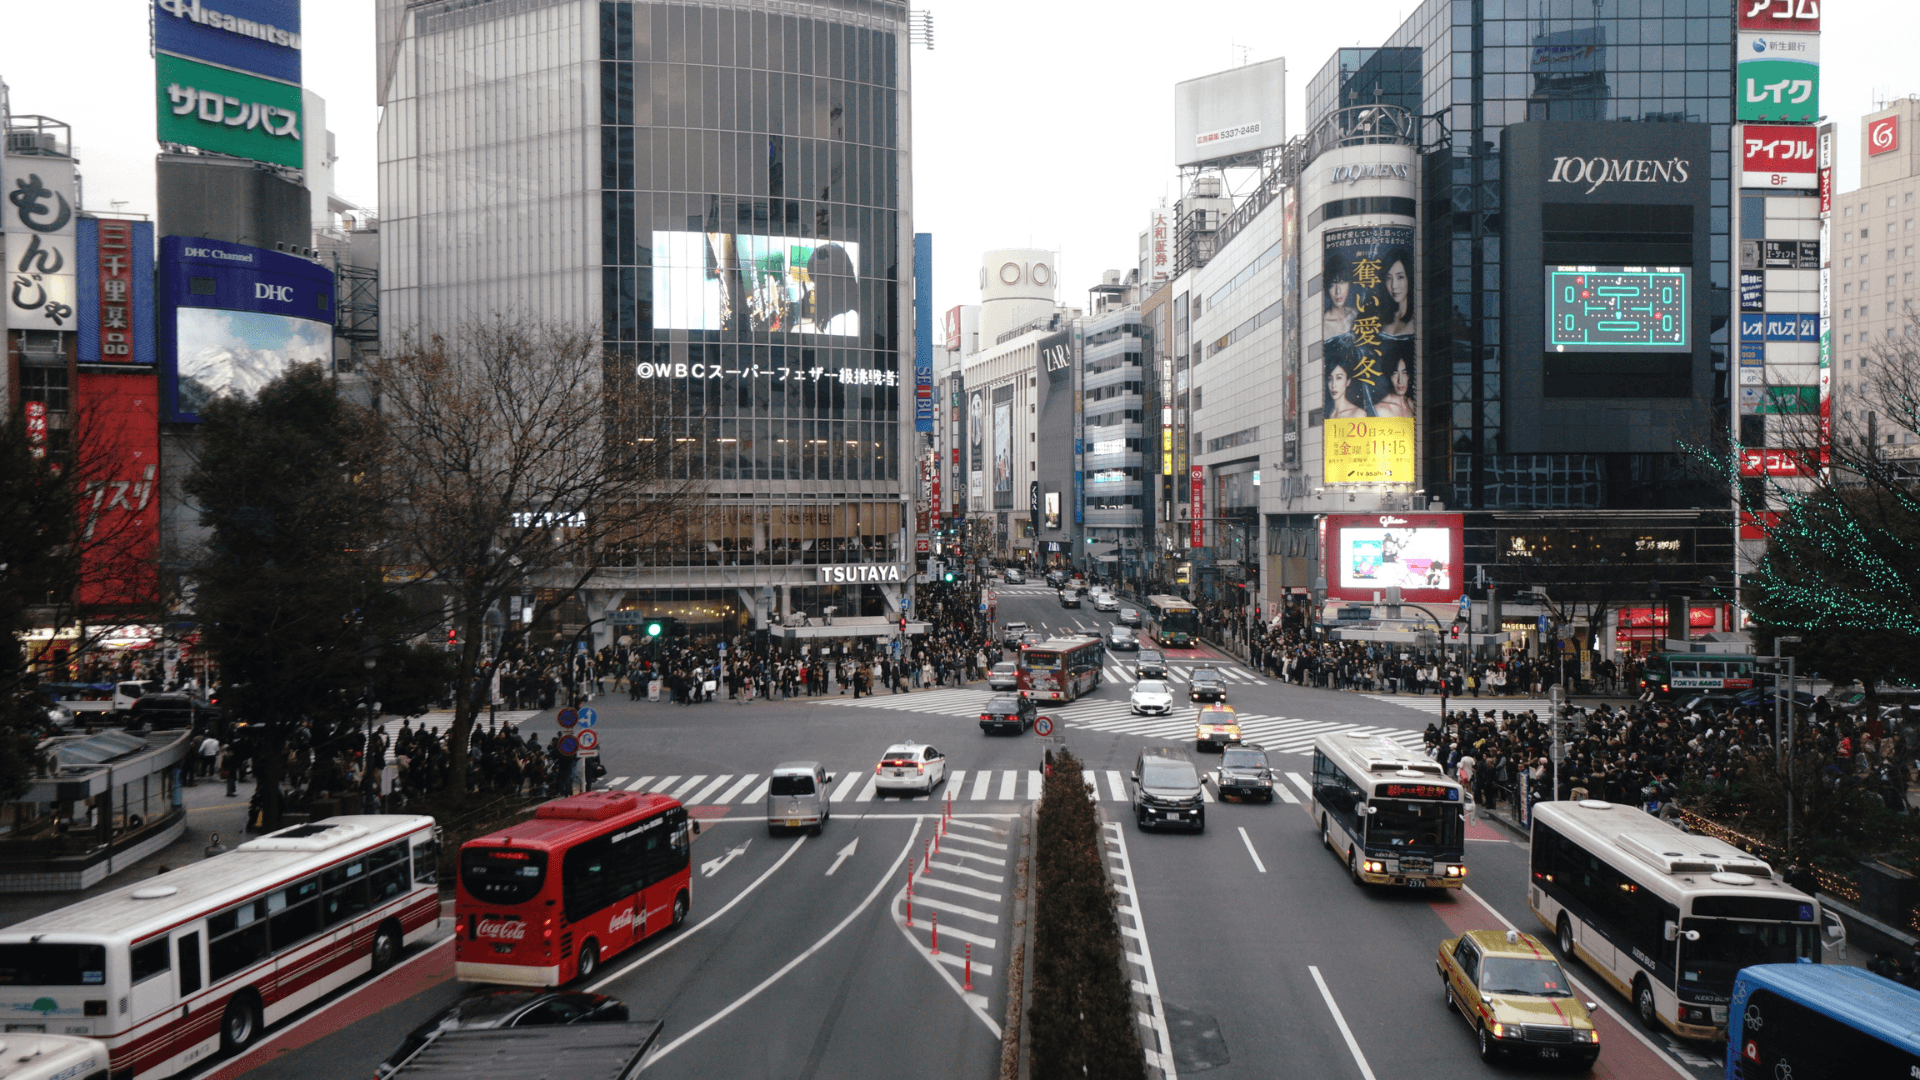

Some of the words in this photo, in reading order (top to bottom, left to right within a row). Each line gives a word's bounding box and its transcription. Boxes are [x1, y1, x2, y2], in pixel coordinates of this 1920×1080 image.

[1769, 41, 1806, 51] 新生銀行
[1746, 78, 1812, 104] レイク
[167, 83, 300, 141] サロンパス
[1220, 124, 1260, 139] 5337-2468
[1745, 139, 1814, 160] アイフル
[1770, 174, 1788, 186] 8F
[1822, 178, 1830, 211] アイフル
[10, 173, 72, 327] もんじゃ
[1154, 213, 1168, 267] 大和証券
[184, 247, 210, 259] DHC
[211, 250, 253, 263] Channel
[103, 225, 129, 355] 三千里薬品
[254, 282, 294, 303] DHC
[1351, 258, 1384, 387] 奪い愛、冬
[1042, 343, 1071, 372] ZARA
[1821, 337, 1830, 364] レイク
[917, 366, 932, 420] SEIBU
[1746, 455, 1795, 470] アコム
[822, 565, 899, 583] TSUTAYA
[1502, 622, 1536, 630] RAGEBLUE
[1672, 680, 1699, 688] TOKYU
[1644, 956, 1657, 970] BUS
